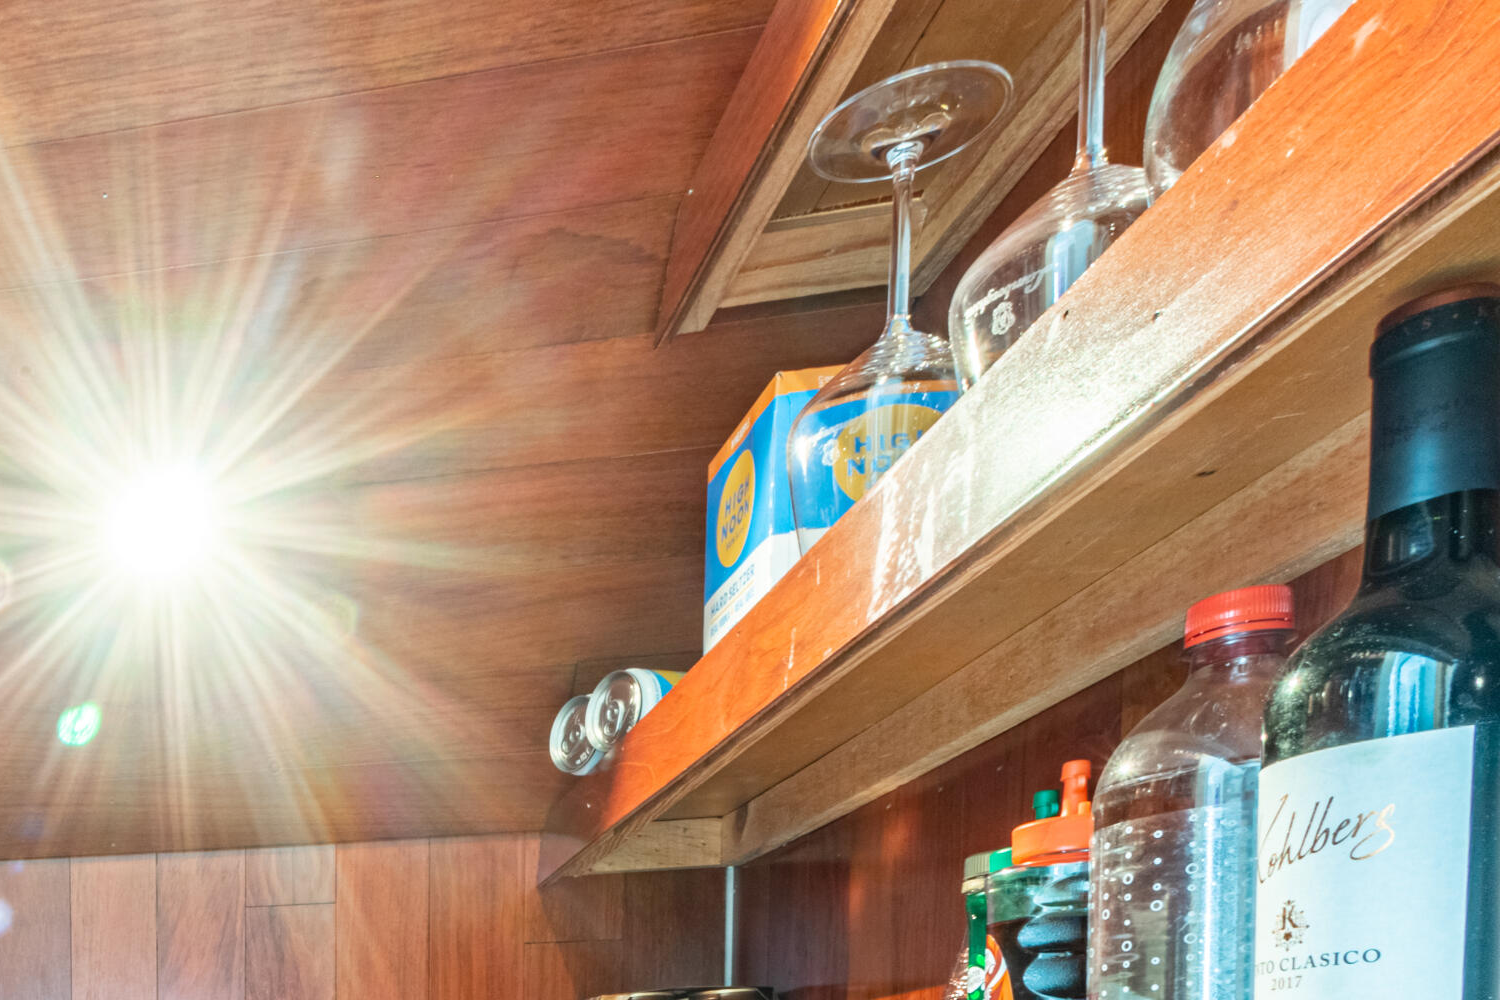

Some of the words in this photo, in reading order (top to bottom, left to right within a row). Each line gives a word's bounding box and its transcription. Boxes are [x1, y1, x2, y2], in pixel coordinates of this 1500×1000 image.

[725, 473, 751, 515] HIGH
[720, 501, 750, 543] NOON
[1280, 947, 1381, 972] CLASICO
[1271, 976, 1303, 991] 2017
